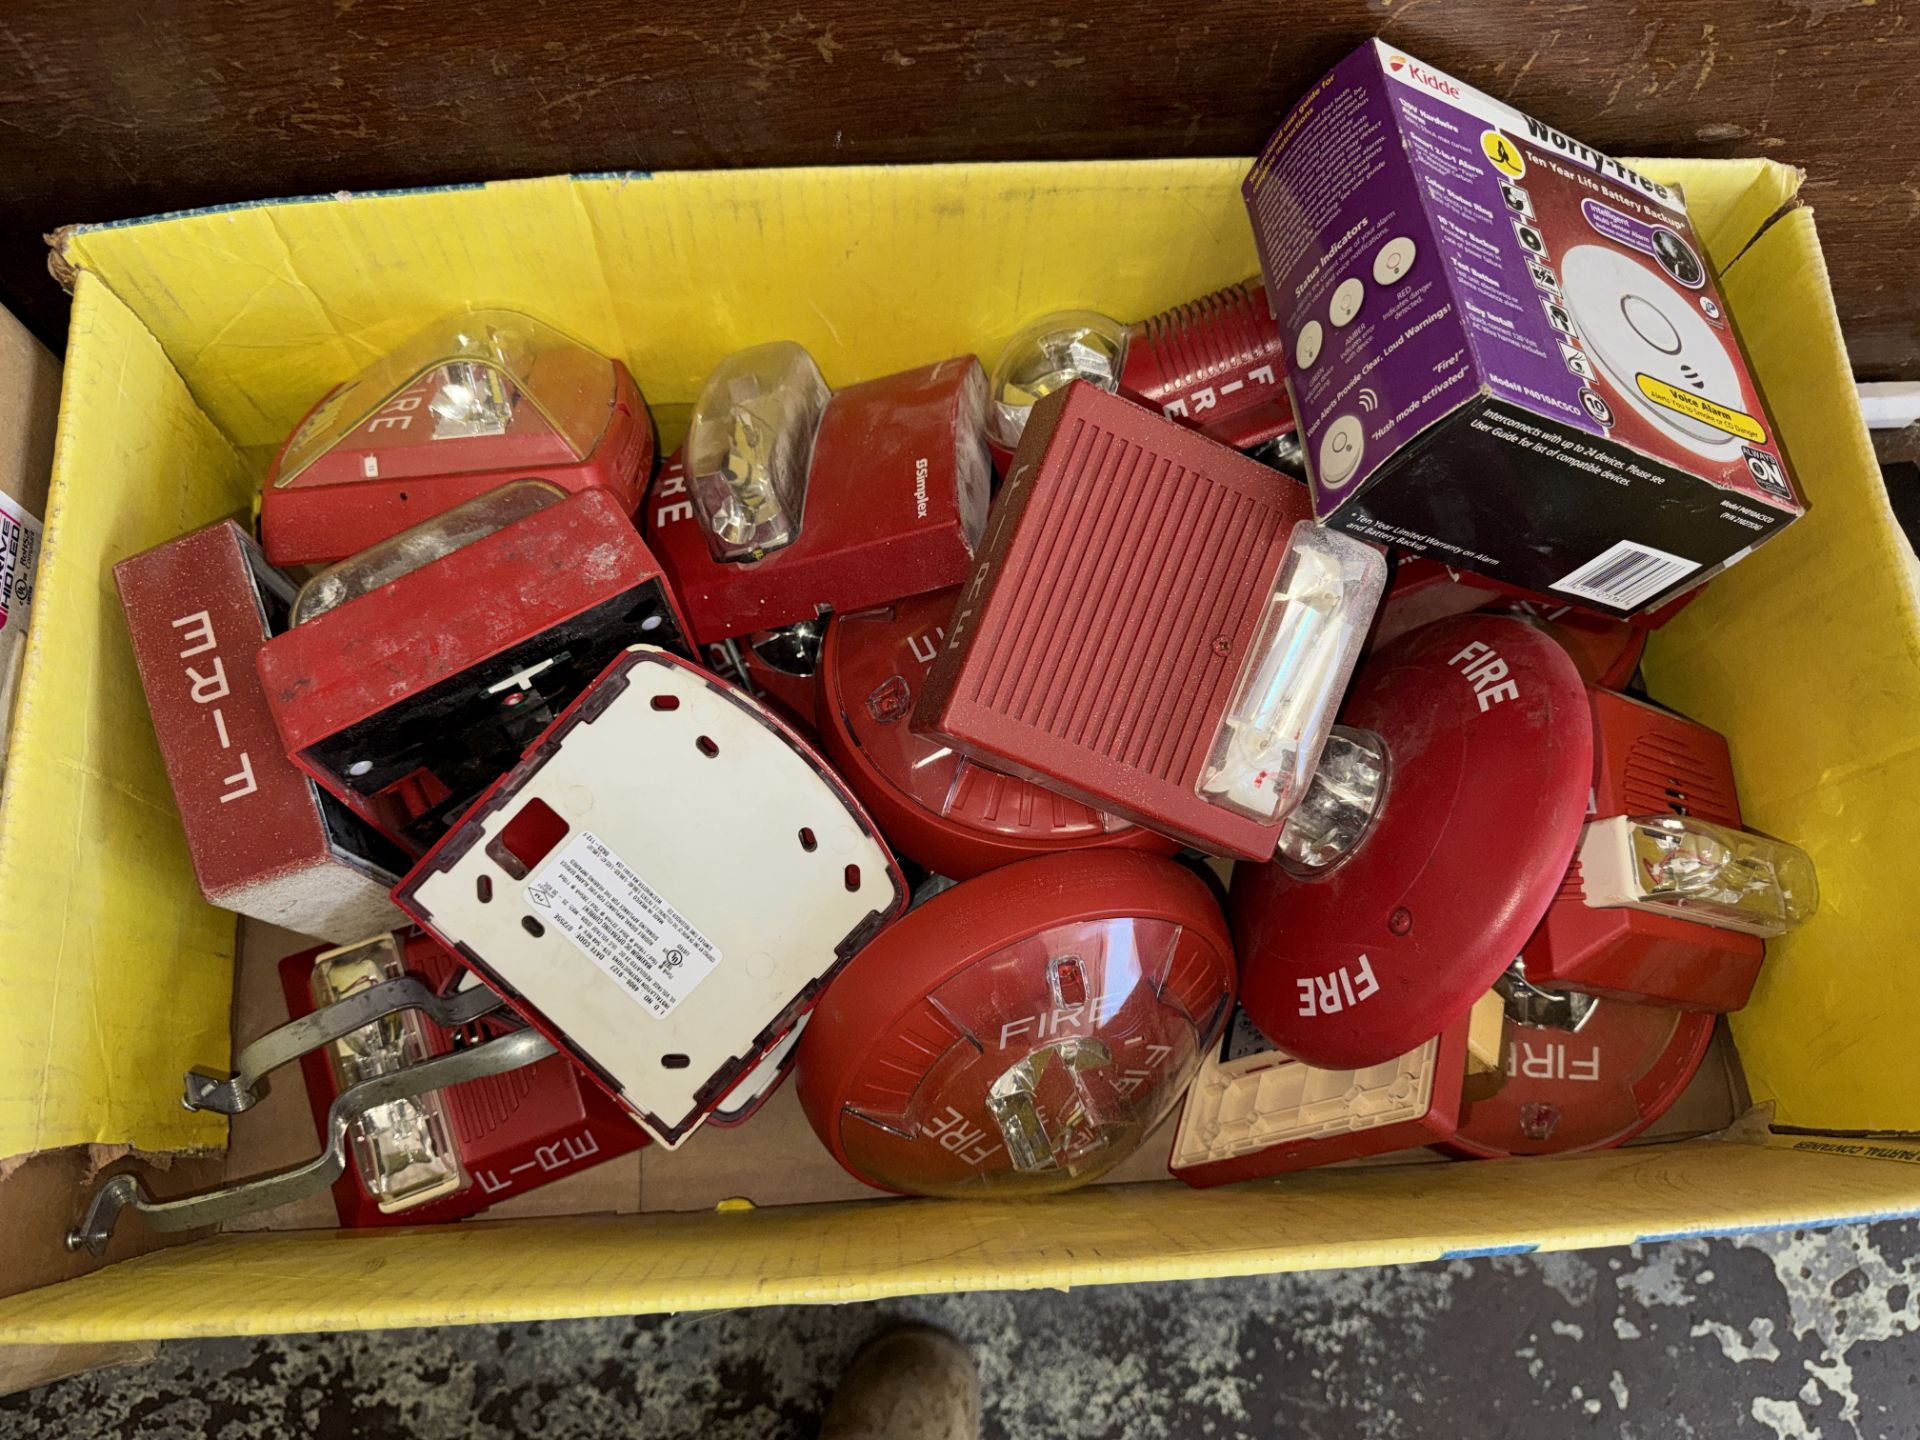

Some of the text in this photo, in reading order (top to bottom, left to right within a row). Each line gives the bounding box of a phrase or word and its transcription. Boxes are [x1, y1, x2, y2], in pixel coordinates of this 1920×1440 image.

[1283, 112, 1298, 132] user
[1299, 88, 1320, 112] guide
[1321, 74, 1334, 88] for
[1409, 64, 1460, 100] Kidde
[1275, 108, 1314, 156] instructions
[1525, 151, 1547, 168] Ten
[1549, 162, 1575, 180] Year
[1577, 174, 1600, 192] Life
[1601, 185, 1642, 213] Battery
[1376, 211, 1396, 228] alarm
[1295, 265, 1320, 298] Status
[1320, 217, 1368, 267] Indicators
[1396, 286, 1412, 300] RED
[1410, 282, 1433, 300] danger
[1345, 323, 1366, 345] AMBER
[1162, 364, 1275, 420] FIRE
[1306, 418, 1320, 438] Voice
[1320, 399, 1337, 420] Alerts
[1337, 374, 1362, 401] Provide
[1362, 355, 1383, 375] Clear,
[1383, 336, 1404, 356] Loud
[1404, 303, 1452, 339] Warnings!
[1396, 401, 1420, 424] mode
[1421, 365, 1470, 404] activated"
[1586, 397, 1605, 413] 10
[1670, 389, 1732, 420] Voice Alarm
[1470, 419, 1631, 487] User Guide for list of compatible devices.
[1482, 408, 1666, 485] Interconnects with up to 24 devices. Please see
[1742, 446, 1776, 464] ALWAYS
[914, 468, 928, 519] Simplex
[1749, 458, 1786, 489] ON
[949, 464, 1030, 649] FIRE
[1346, 522, 1428, 551] and Battery Backup
[1356, 514, 1374, 525] Ten
[1374, 520, 1395, 531] Year
[1393, 526, 1428, 541] Limited
[1425, 537, 1463, 554] Warranty
[1473, 553, 1500, 566] Alarm
[1448, 640, 1520, 712] FIRE
[172, 610, 258, 804] FIRE
[589, 945, 605, 960] DATE
[600, 921, 626, 945] OPERATING
[629, 947, 653, 970] MAXIMUM
[1297, 953, 1380, 1016] FIRE
[999, 992, 1119, 1050] FIRE
[475, 1129, 599, 1194] FIRE
[922, 1106, 1003, 1165] FIRE
